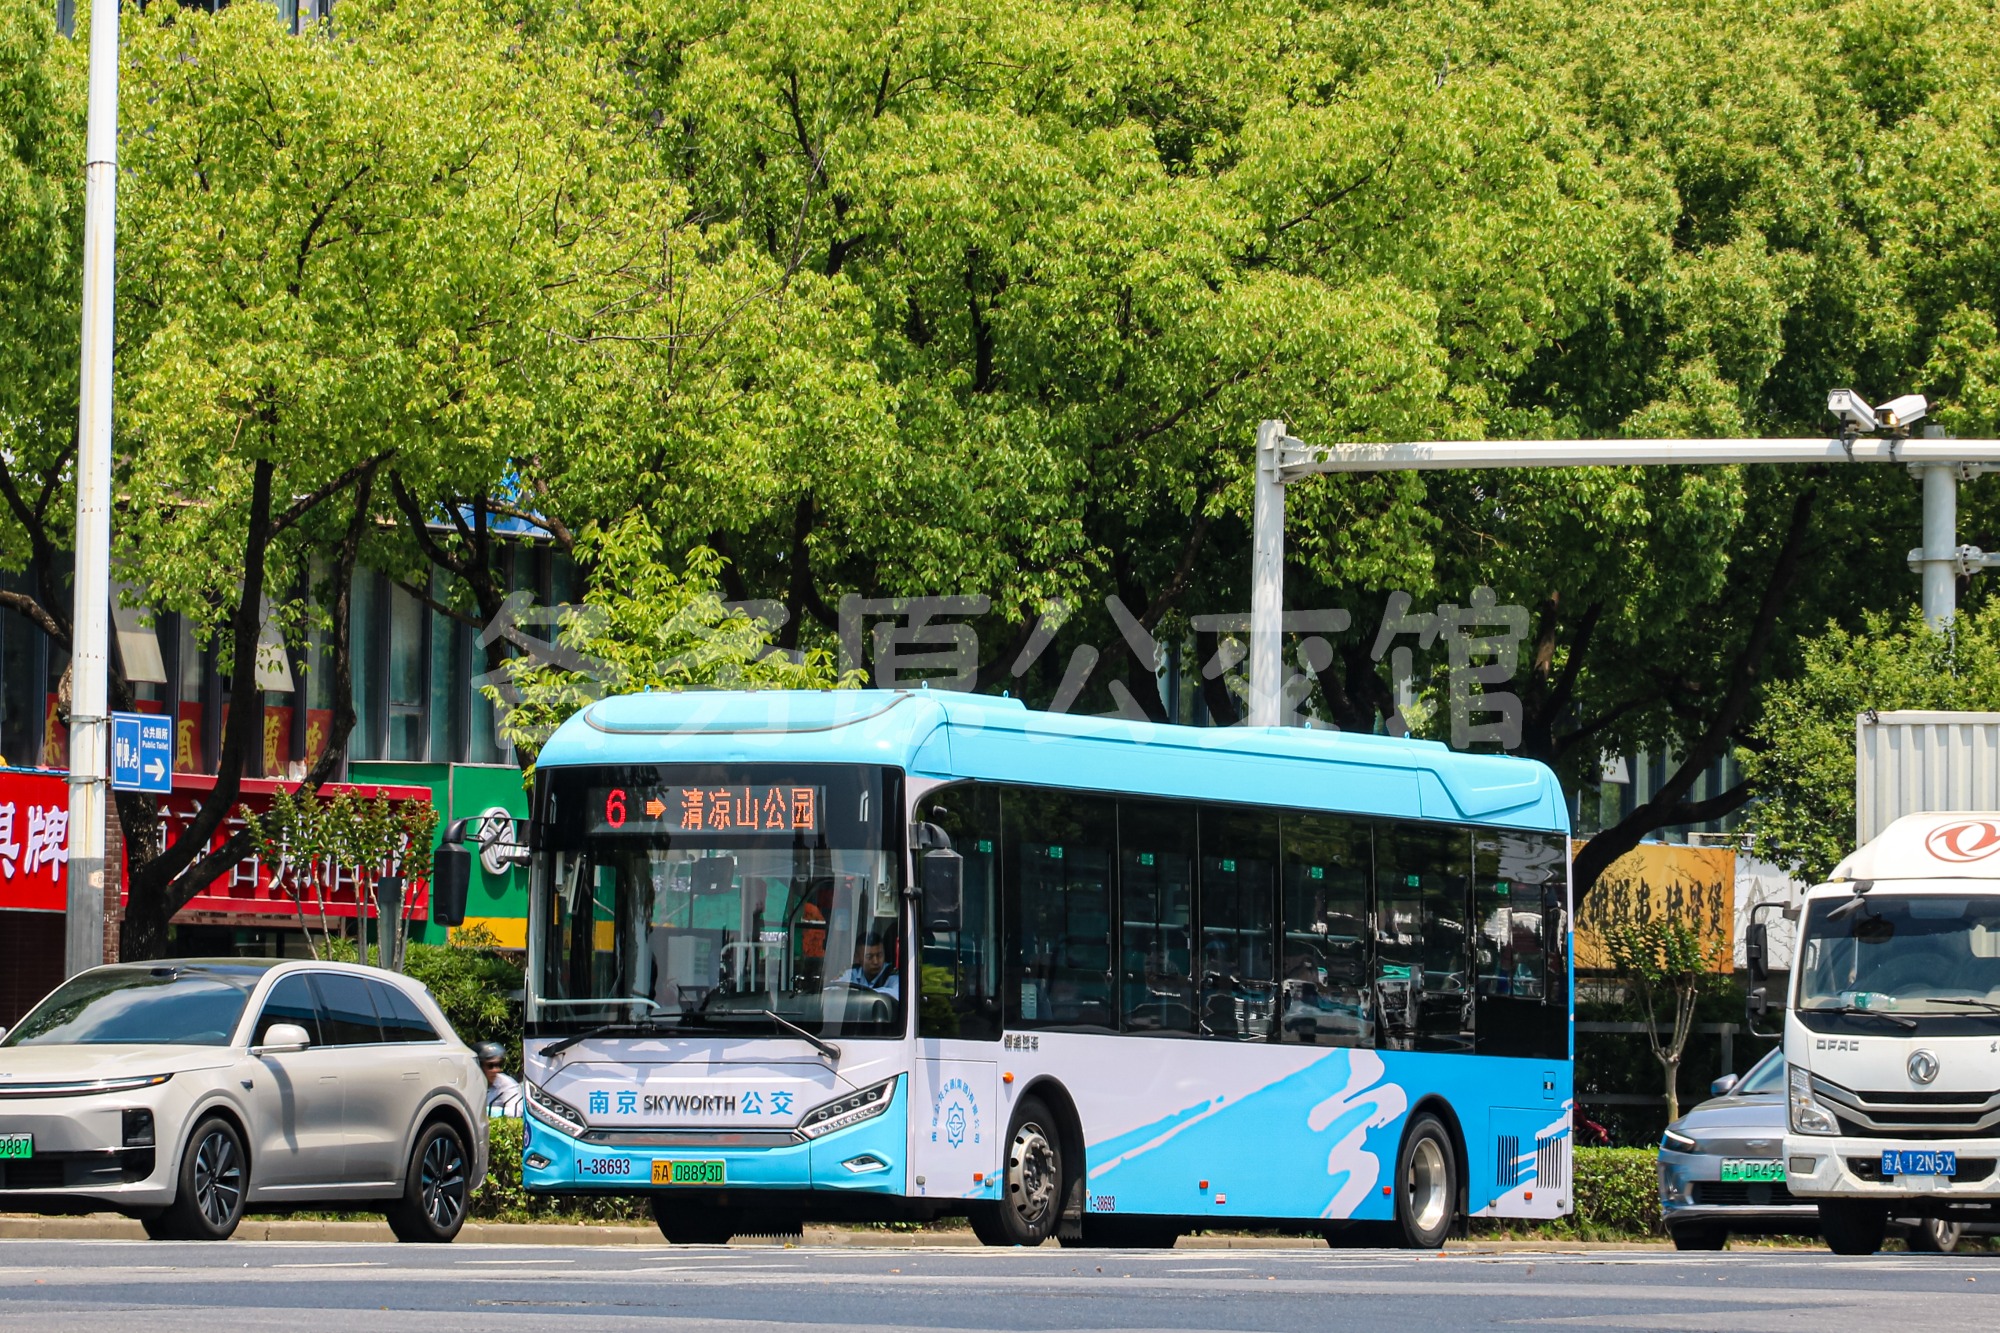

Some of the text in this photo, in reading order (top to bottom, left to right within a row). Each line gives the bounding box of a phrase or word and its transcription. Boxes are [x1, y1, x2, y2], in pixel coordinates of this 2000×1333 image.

[143, 727, 168, 740] 公共厕所
[142, 741, 169, 750] Public Toilet
[606, 787, 814, 830] 6 清凉山公园
[1817, 1040, 1859, 1051] DFAC
[589, 1090, 793, 1115] 南京 SKYWORTH 公交
[576, 1158, 630, 1175] 1-38693
[1089, 1195, 1116, 1211] 1-38693
